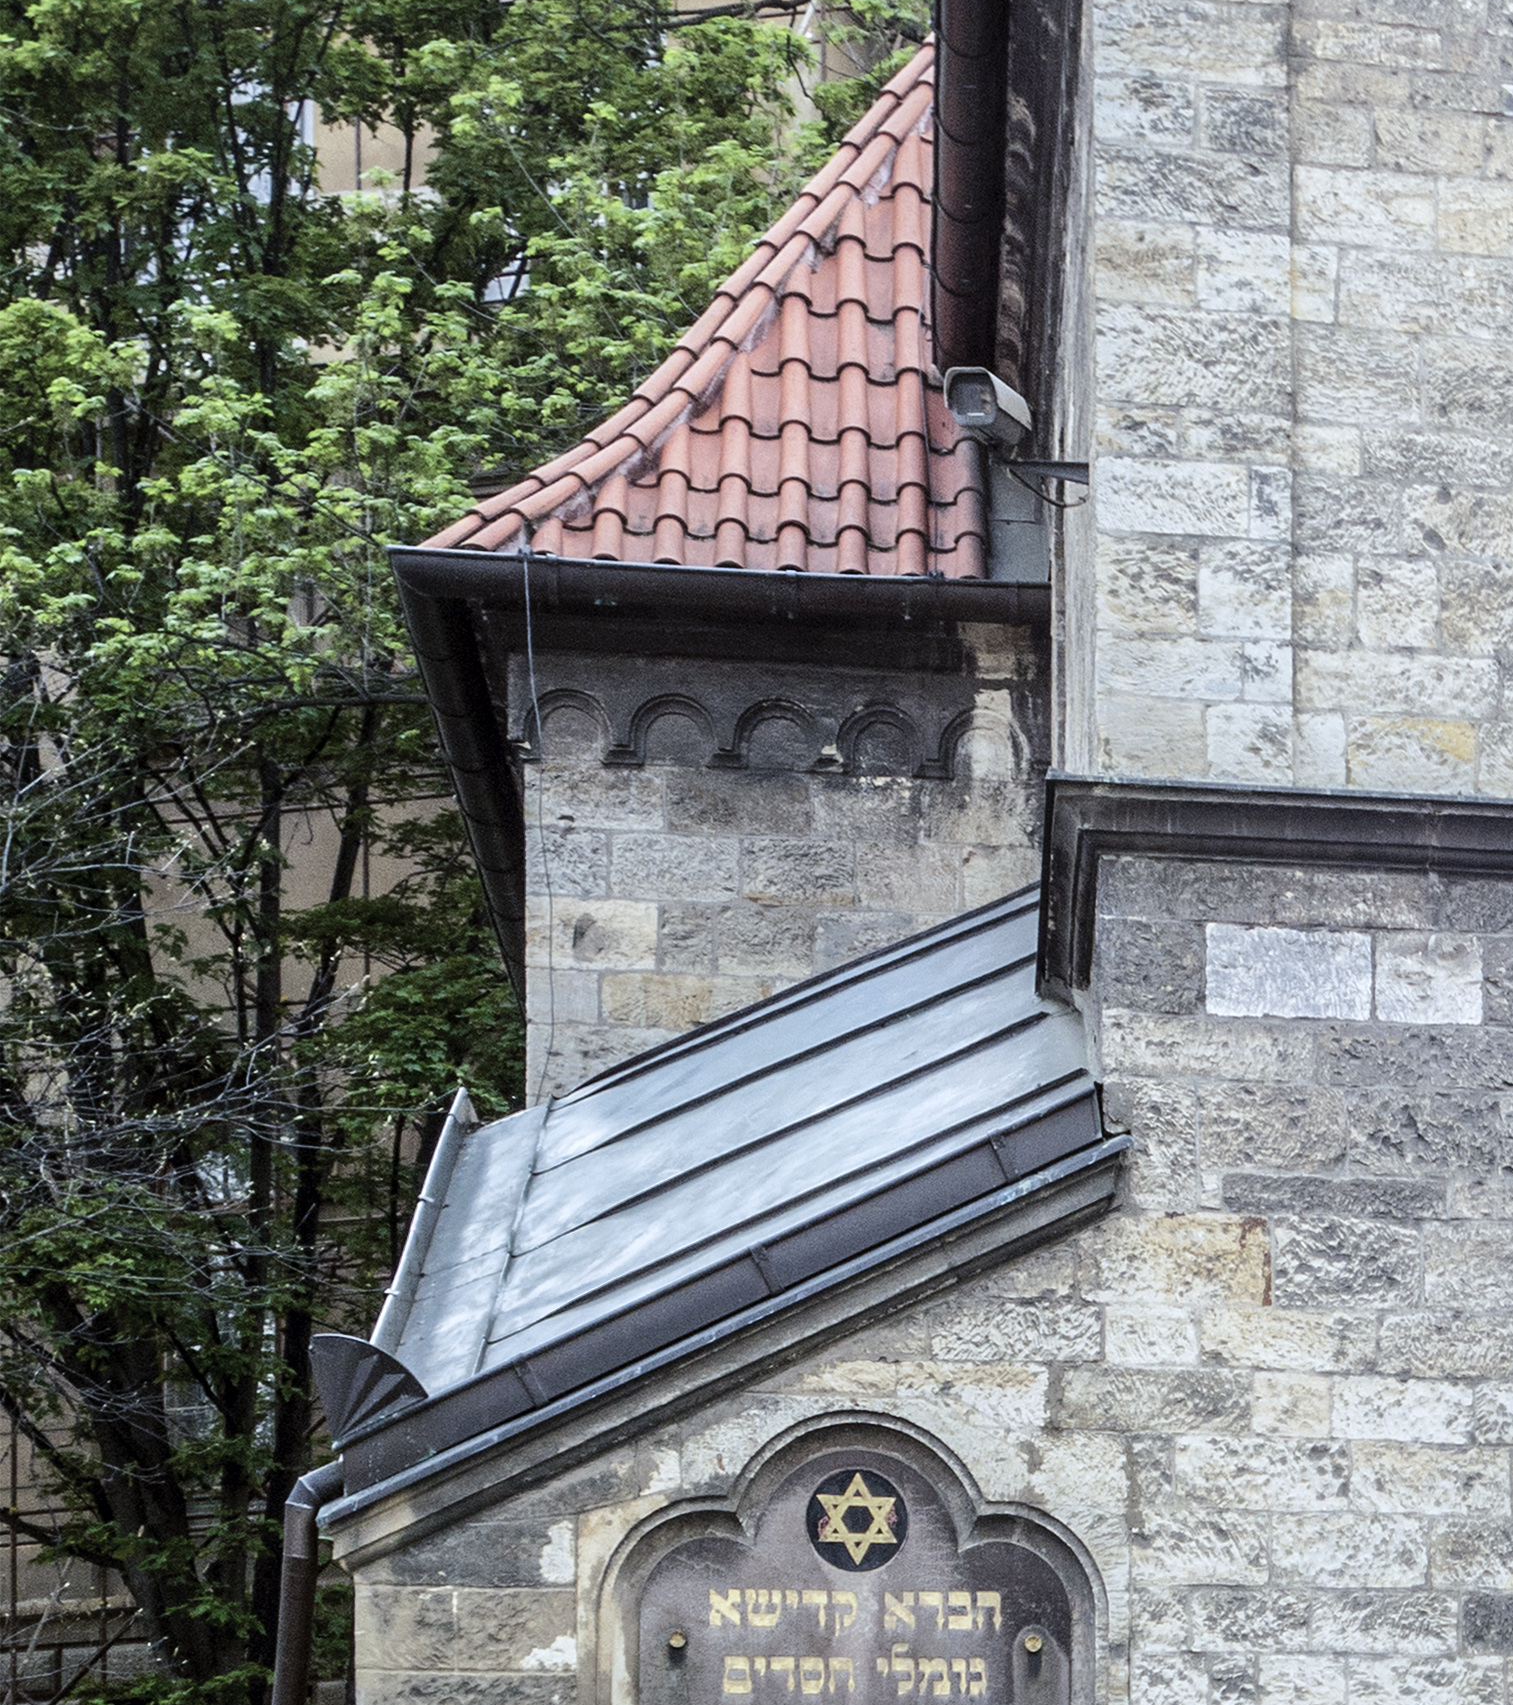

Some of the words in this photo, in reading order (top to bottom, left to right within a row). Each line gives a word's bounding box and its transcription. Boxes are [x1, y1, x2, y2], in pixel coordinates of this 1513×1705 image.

[708, 1587, 858, 1637] קדישא
[883, 1589, 1002, 1631] חברא
[722, 1655, 855, 1695] חסדים
[876, 1642, 987, 1696] גומלי
